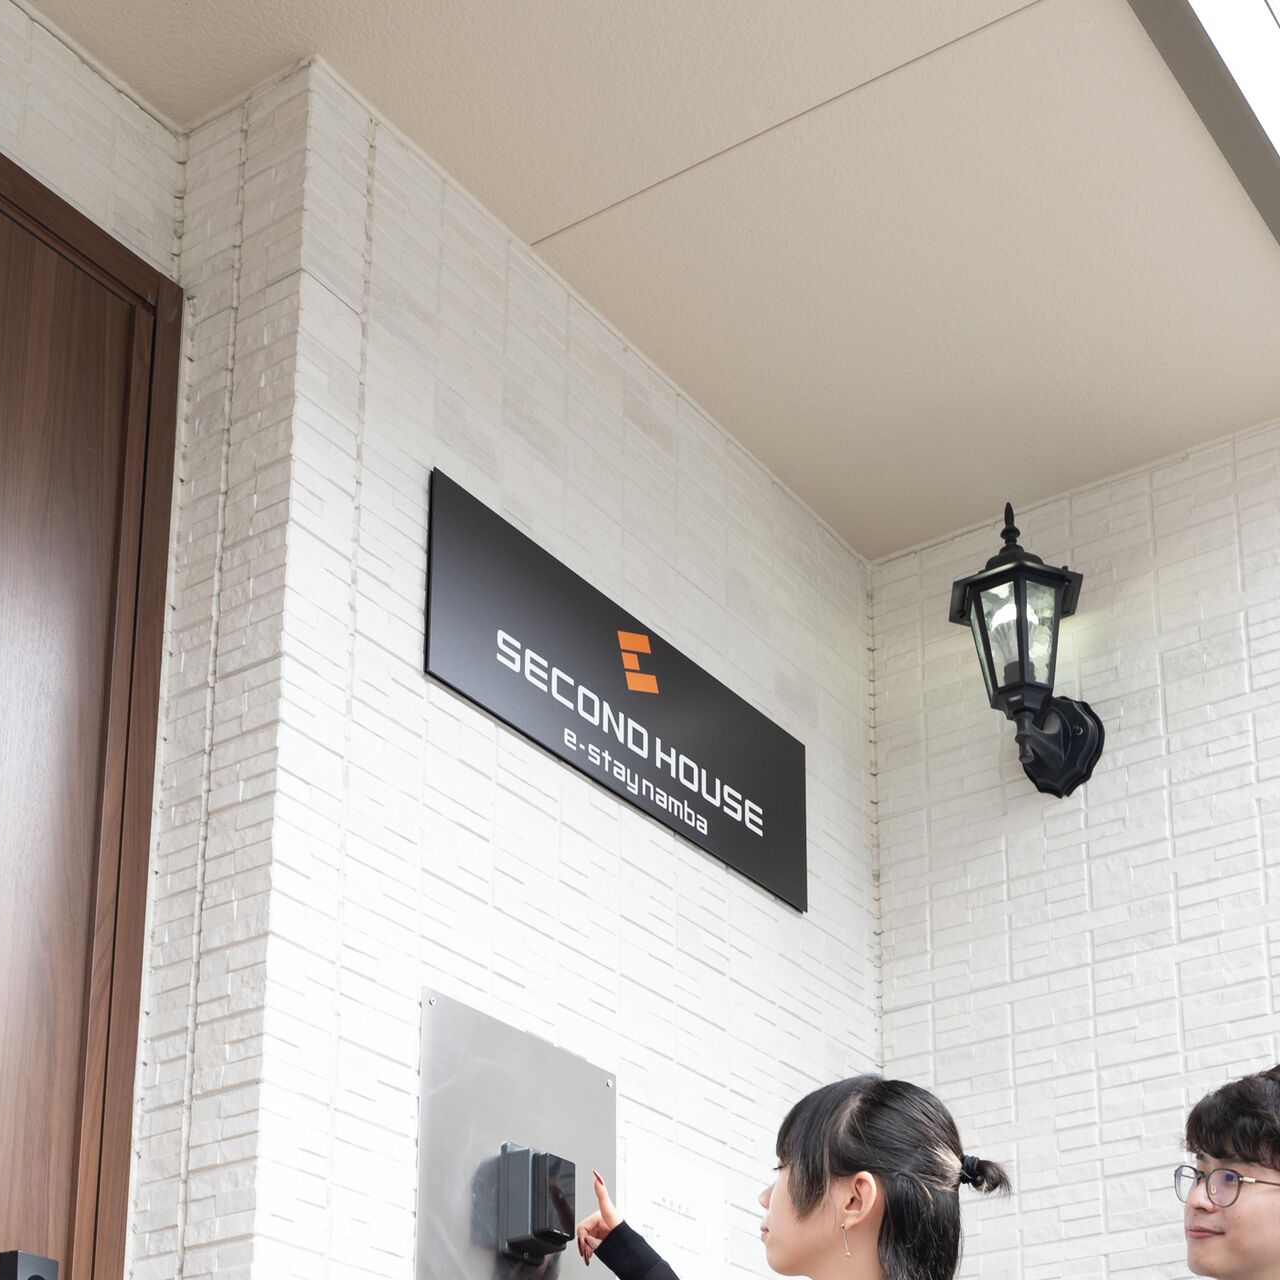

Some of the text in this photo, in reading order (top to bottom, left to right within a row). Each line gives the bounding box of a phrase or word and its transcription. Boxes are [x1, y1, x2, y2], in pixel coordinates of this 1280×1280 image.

[496, 629, 763, 837] SECOND HOUSE
[564, 728, 708, 836] e-stay namba
